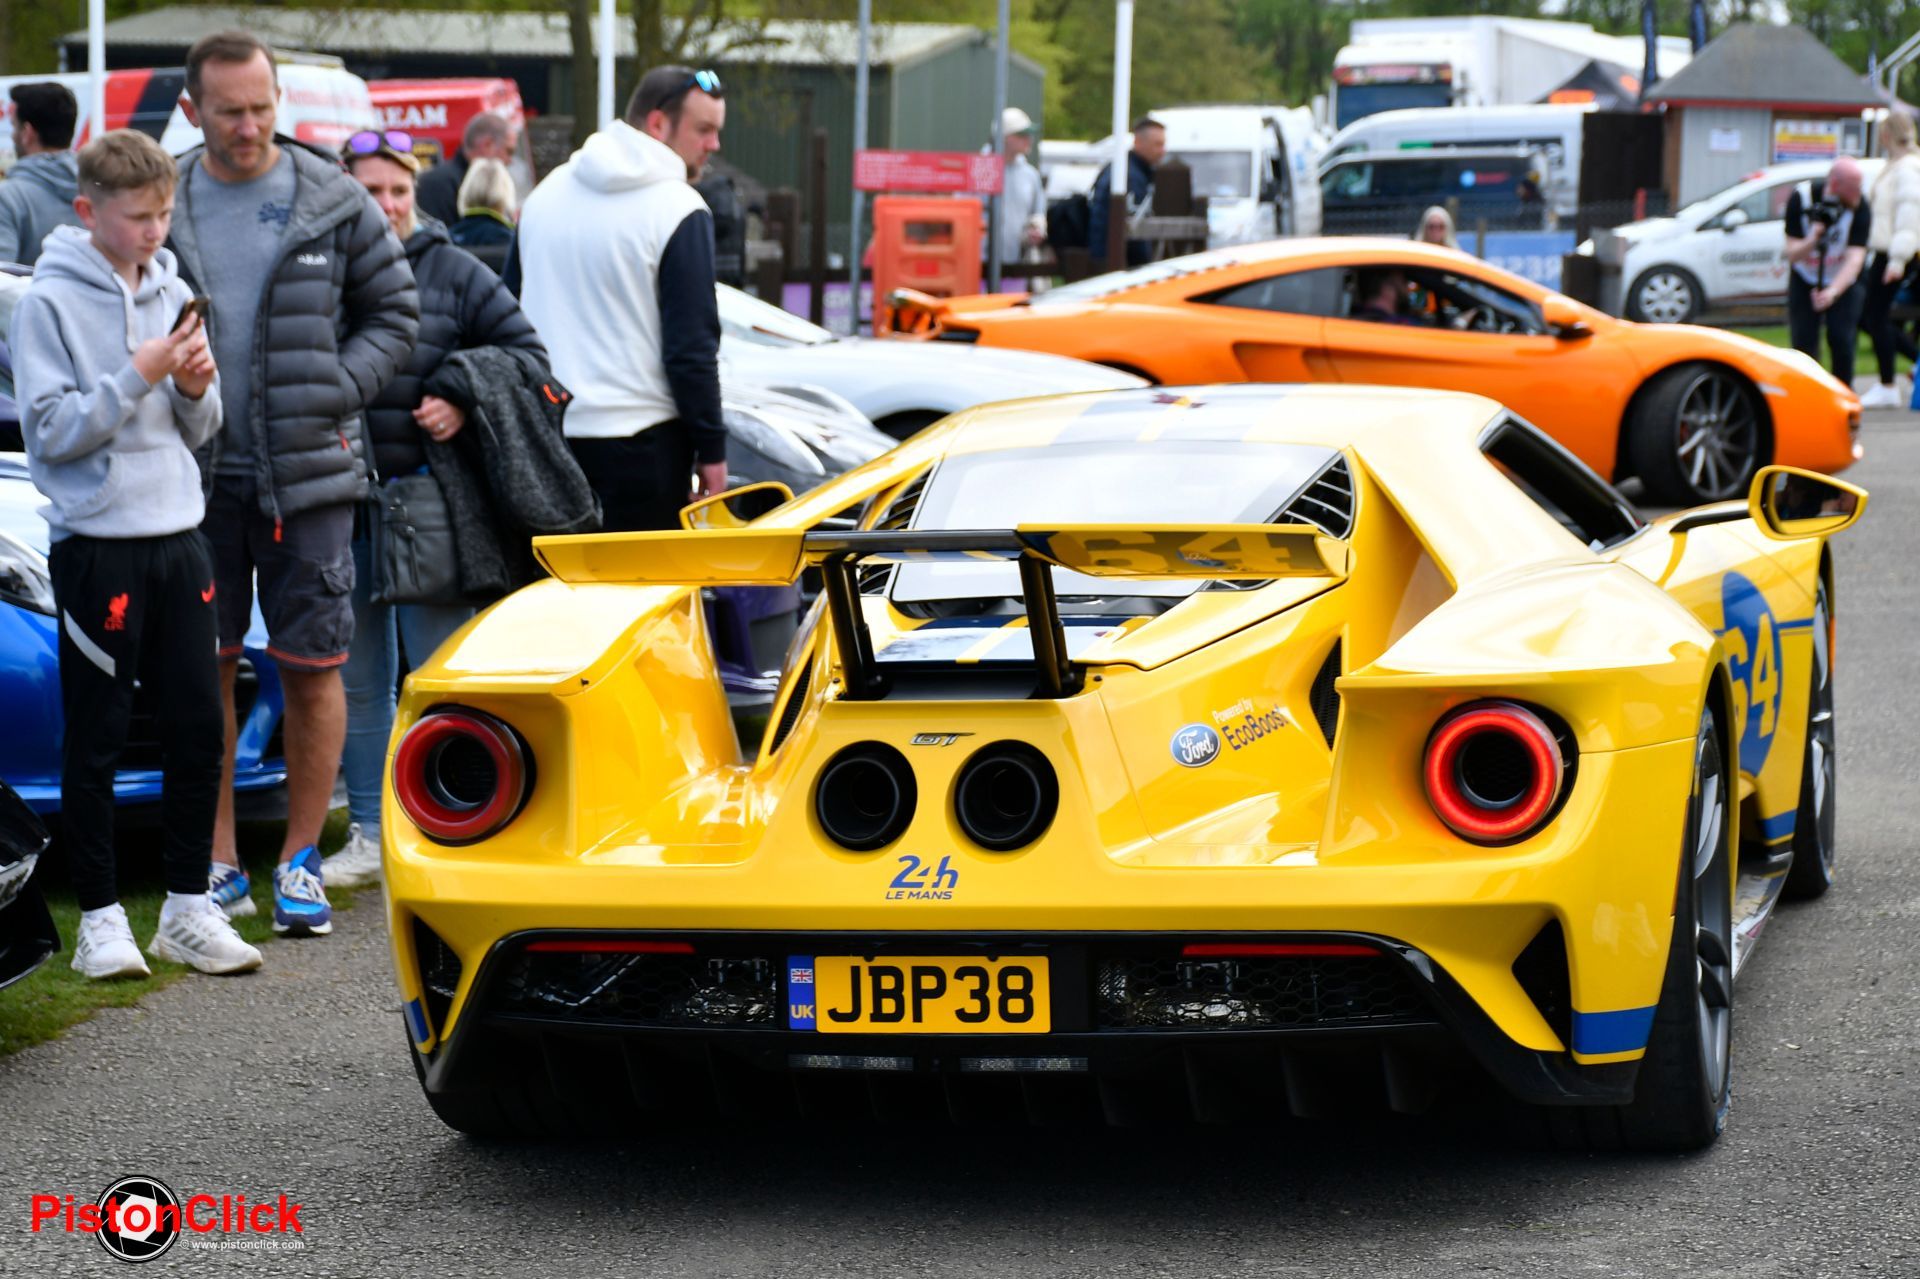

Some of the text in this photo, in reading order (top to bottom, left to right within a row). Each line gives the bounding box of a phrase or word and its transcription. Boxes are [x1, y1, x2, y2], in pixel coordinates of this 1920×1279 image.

[1719, 612, 1779, 739] 64
[1212, 699, 1245, 724] Powered
[910, 732, 977, 747] GT
[1180, 730, 1214, 763] Ford
[885, 890, 953, 900] LE MANS
[827, 965, 1034, 1023] JBP38
[790, 1004, 815, 1019] UK
